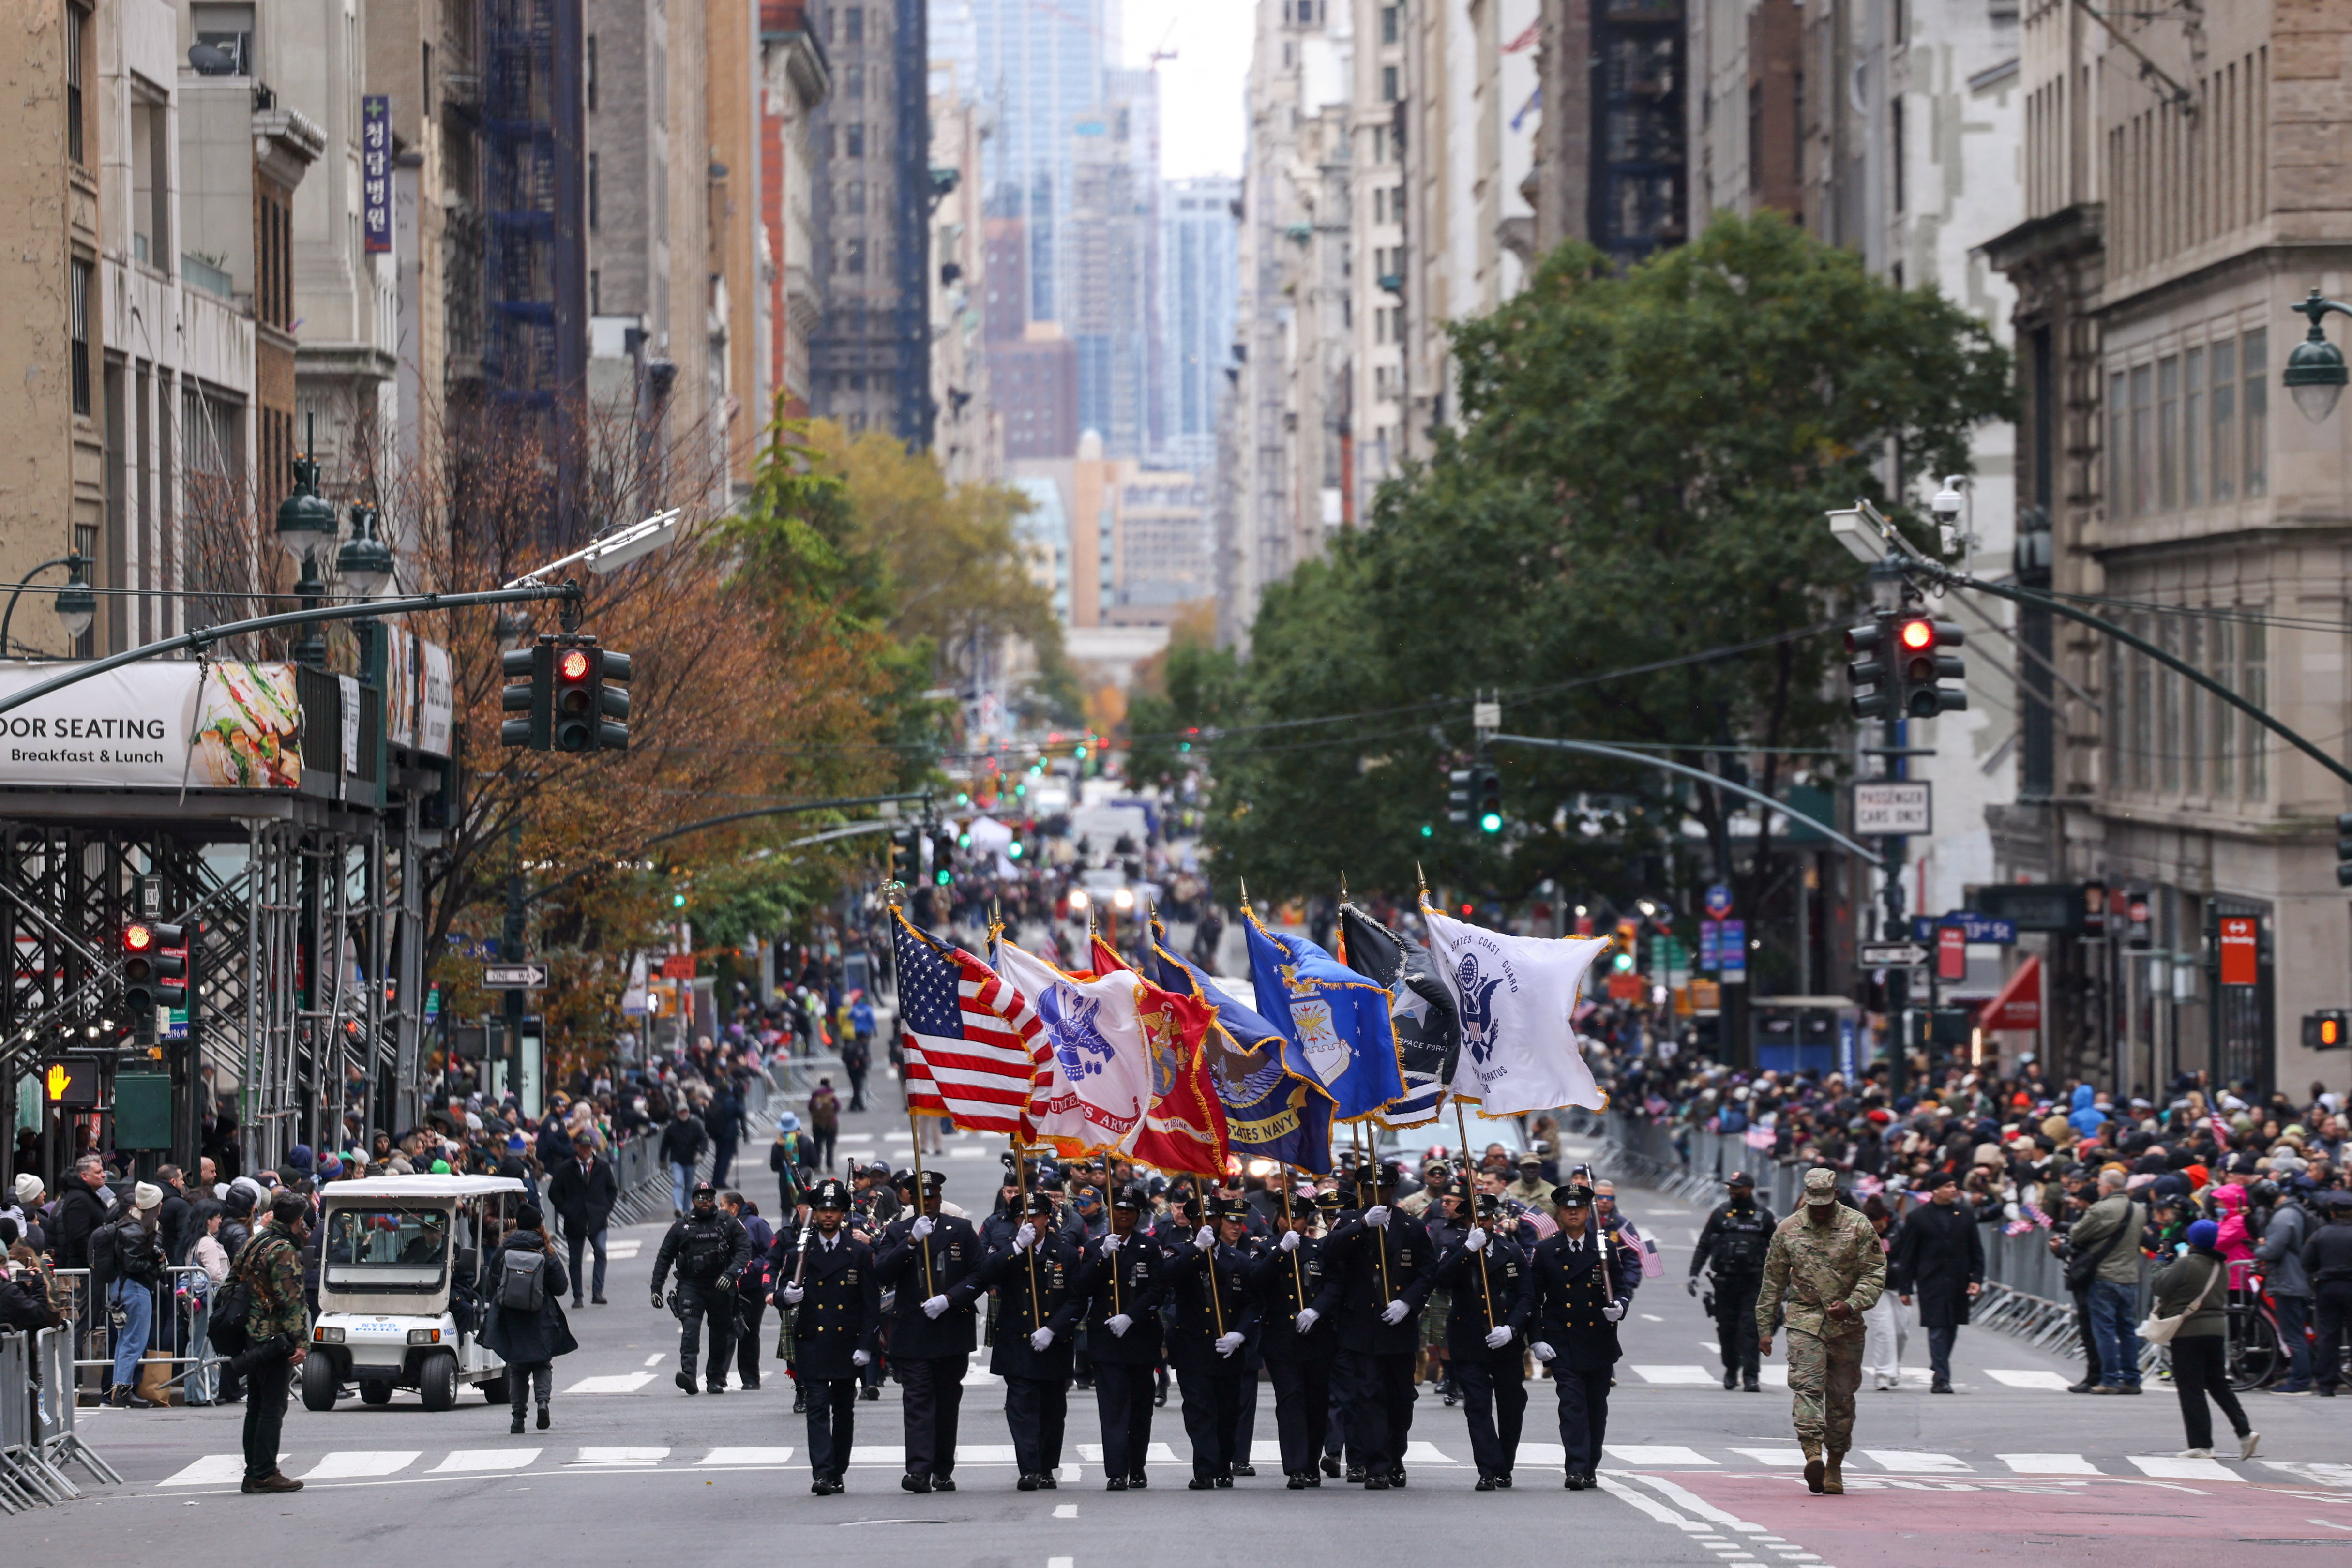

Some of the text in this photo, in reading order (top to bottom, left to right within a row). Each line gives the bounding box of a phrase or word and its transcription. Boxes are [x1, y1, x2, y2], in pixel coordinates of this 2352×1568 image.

[54, 718, 165, 739] SEATING
[12, 748, 163, 763] Breakfast & Lunch
[1861, 791, 1922, 804] PASSENGER
[1860, 810, 1922, 823] CARS ONLY
[1451, 935, 1518, 993] STATES COAST GUARD
[493, 971, 538, 981] ONE WAY
[1399, 1038, 1448, 1052] SPACE FORCE
[1481, 1065, 1508, 1082] PARATUS
[1100, 1115, 1135, 1133] ARMY
[1163, 1118, 1189, 1131] MARINE
[1262, 1114, 1294, 1139] NAVY
